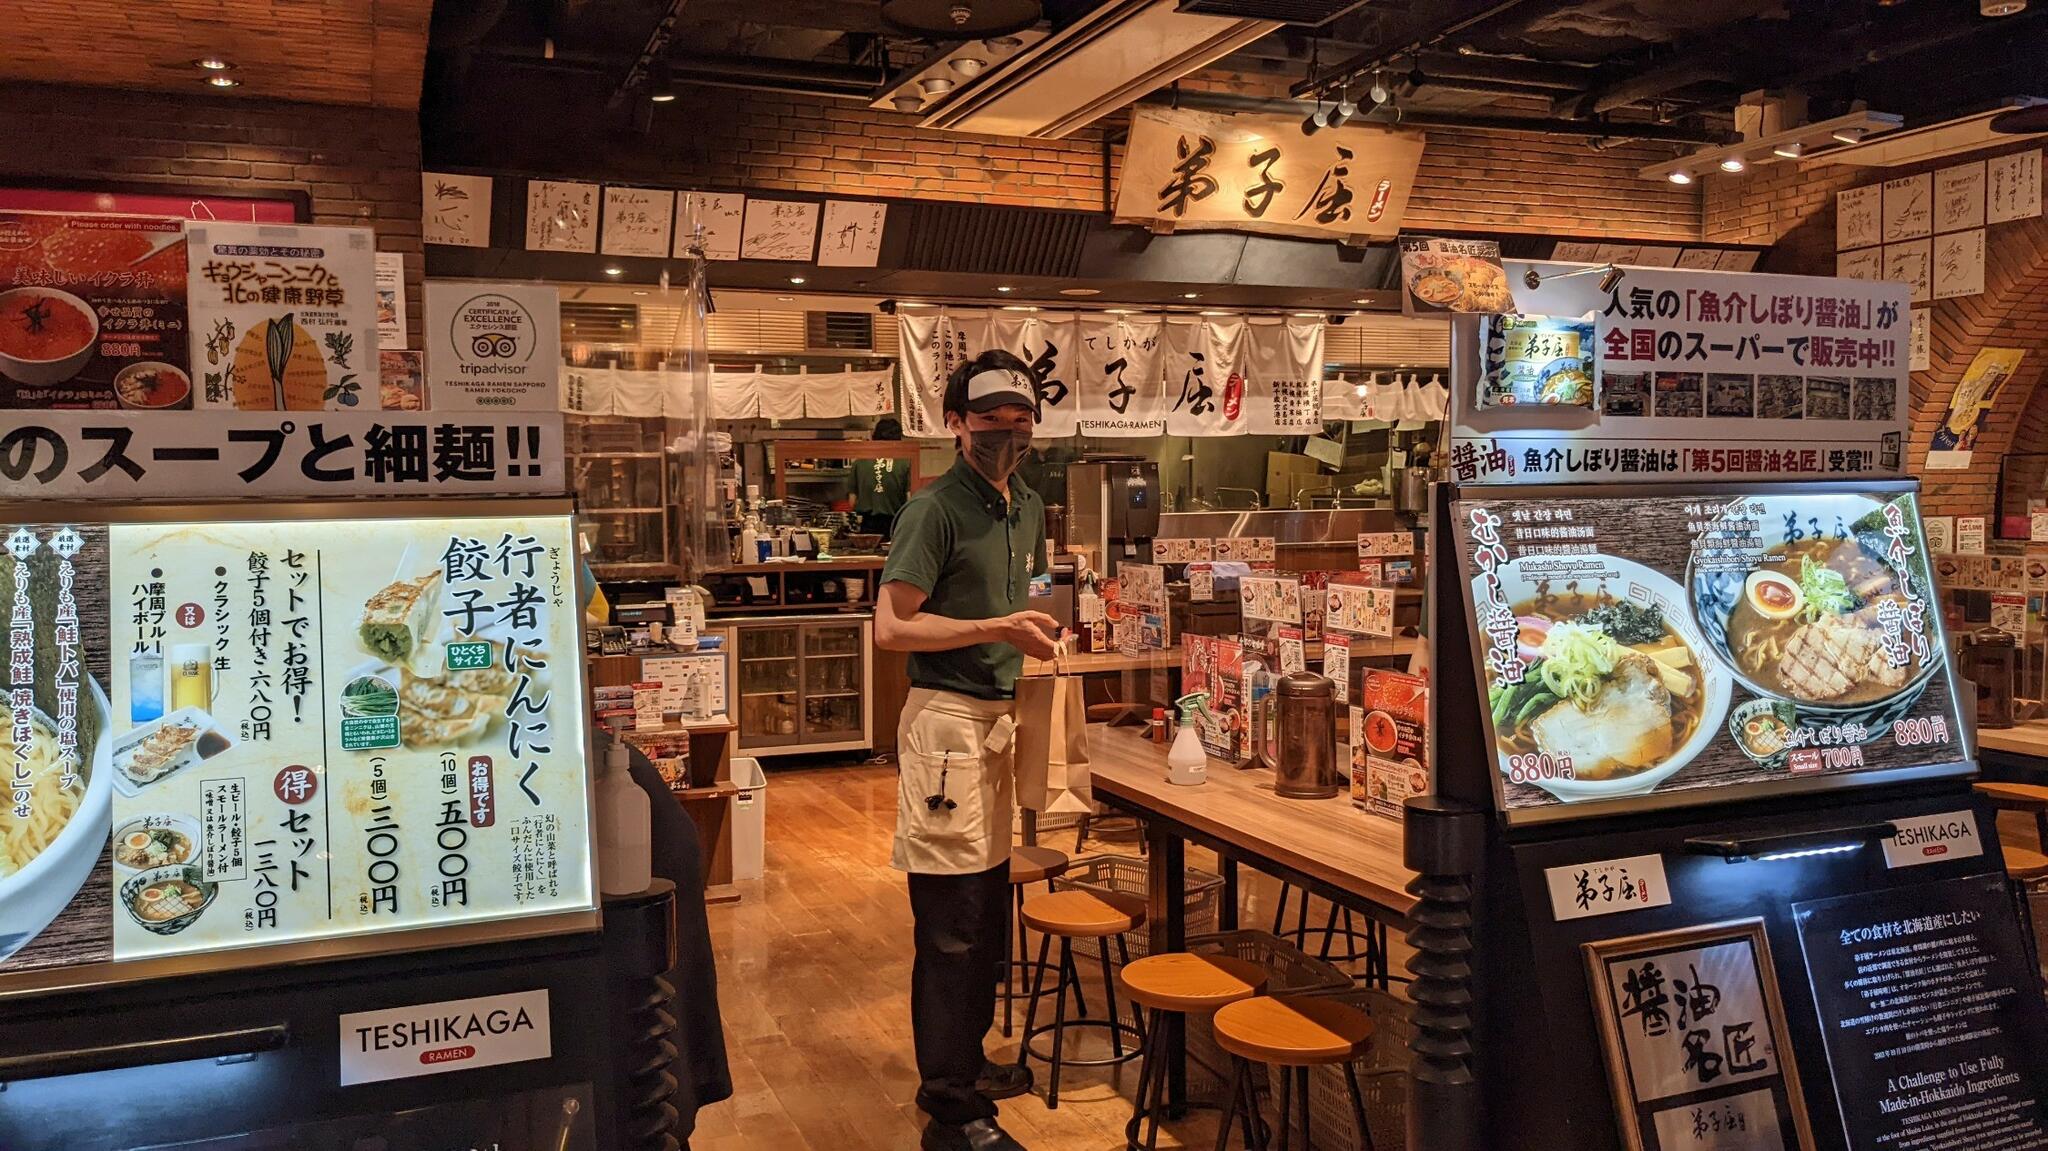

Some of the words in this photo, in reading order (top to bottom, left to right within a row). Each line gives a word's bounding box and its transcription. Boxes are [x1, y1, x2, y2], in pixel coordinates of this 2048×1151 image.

[1368, 179, 1391, 222] ラーメン
[71, 220, 98, 229] Please
[100, 221, 123, 229] order
[125, 222, 142, 230] with
[222, 283, 345, 308] 北の健康野草
[468, 308, 510, 316] CERTIFICATE
[1603, 286, 1899, 330] 人気の「魚介しぼり醤油」が
[464, 315, 522, 324] EXCELLENCE
[101, 342, 142, 357] 880円
[1084, 336, 1158, 352] てしかが
[1603, 327, 1896, 369] 全国のスーパーで販売中!!
[460, 363, 527, 377] tripadvisor
[931, 330, 943, 398] このラーメン。
[445, 380, 485, 388] TESHIKAGA
[514, 381, 546, 389] SAPPORO
[1226, 374, 1242, 418] ラーメン
[1534, 509, 1551, 521] 간장
[1555, 508, 1573, 521] 라면
[549, 546, 564, 609] ぎょうじゃ
[1519, 561, 1553, 572] Mukashi
[1553, 560, 1578, 574] Shoyu
[1579, 560, 1605, 570] Ramen
[1693, 554, 1740, 566] Gyokaishibori
[1740, 554, 1762, 565] Shoyu
[1762, 553, 1786, 562] Ramen
[440, 536, 495, 637] 餃子
[1470, 508, 1526, 688] むかし醤油
[132, 582, 150, 654] ハイボール
[148, 581, 167, 655] 摩周ブルー
[184, 605, 197, 627] 又は
[280, 548, 314, 724] セットでお得!
[451, 644, 486, 656] ひとくち
[454, 655, 484, 667] サイズ
[494, 533, 552, 806] 行者にんにく
[1893, 717, 1949, 746] 880円
[1508, 751, 1577, 785] 880円
[1790, 752, 1819, 762] スモール
[1793, 763, 1809, 771] Small
[1821, 746, 1864, 769] 700円
[280, 769, 313, 799] 得
[471, 761, 490, 825] お得です
[217, 784, 229, 873] スモールラーメン付
[281, 809, 319, 892] セット
[510, 819, 524, 905] 一口サイズ餃子です。
[522, 816, 535, 900] ふんだんに使用した
[545, 814, 559, 897] 幻の山菜と呼ばれる
[1839, 910, 1981, 946] 全ての食材を北海道産にしたい
[1621, 962, 1721, 1037] 醤油
[356, 1006, 535, 1053] TESHIKAGA
[428, 1047, 468, 1062] RAMEN
[1681, 1021, 1768, 1083] 名匠
[1879, 1083, 1966, 1115] Made-in-Hokkaido
[1967, 1071, 2020, 1094] Ingredients
[1888, 1079, 1897, 1093] A
[1898, 1071, 1946, 1090] Challenge
[1948, 1067, 1958, 1079] to
[1959, 1061, 1979, 1077] Use
[1980, 1054, 2005, 1072] Fully
